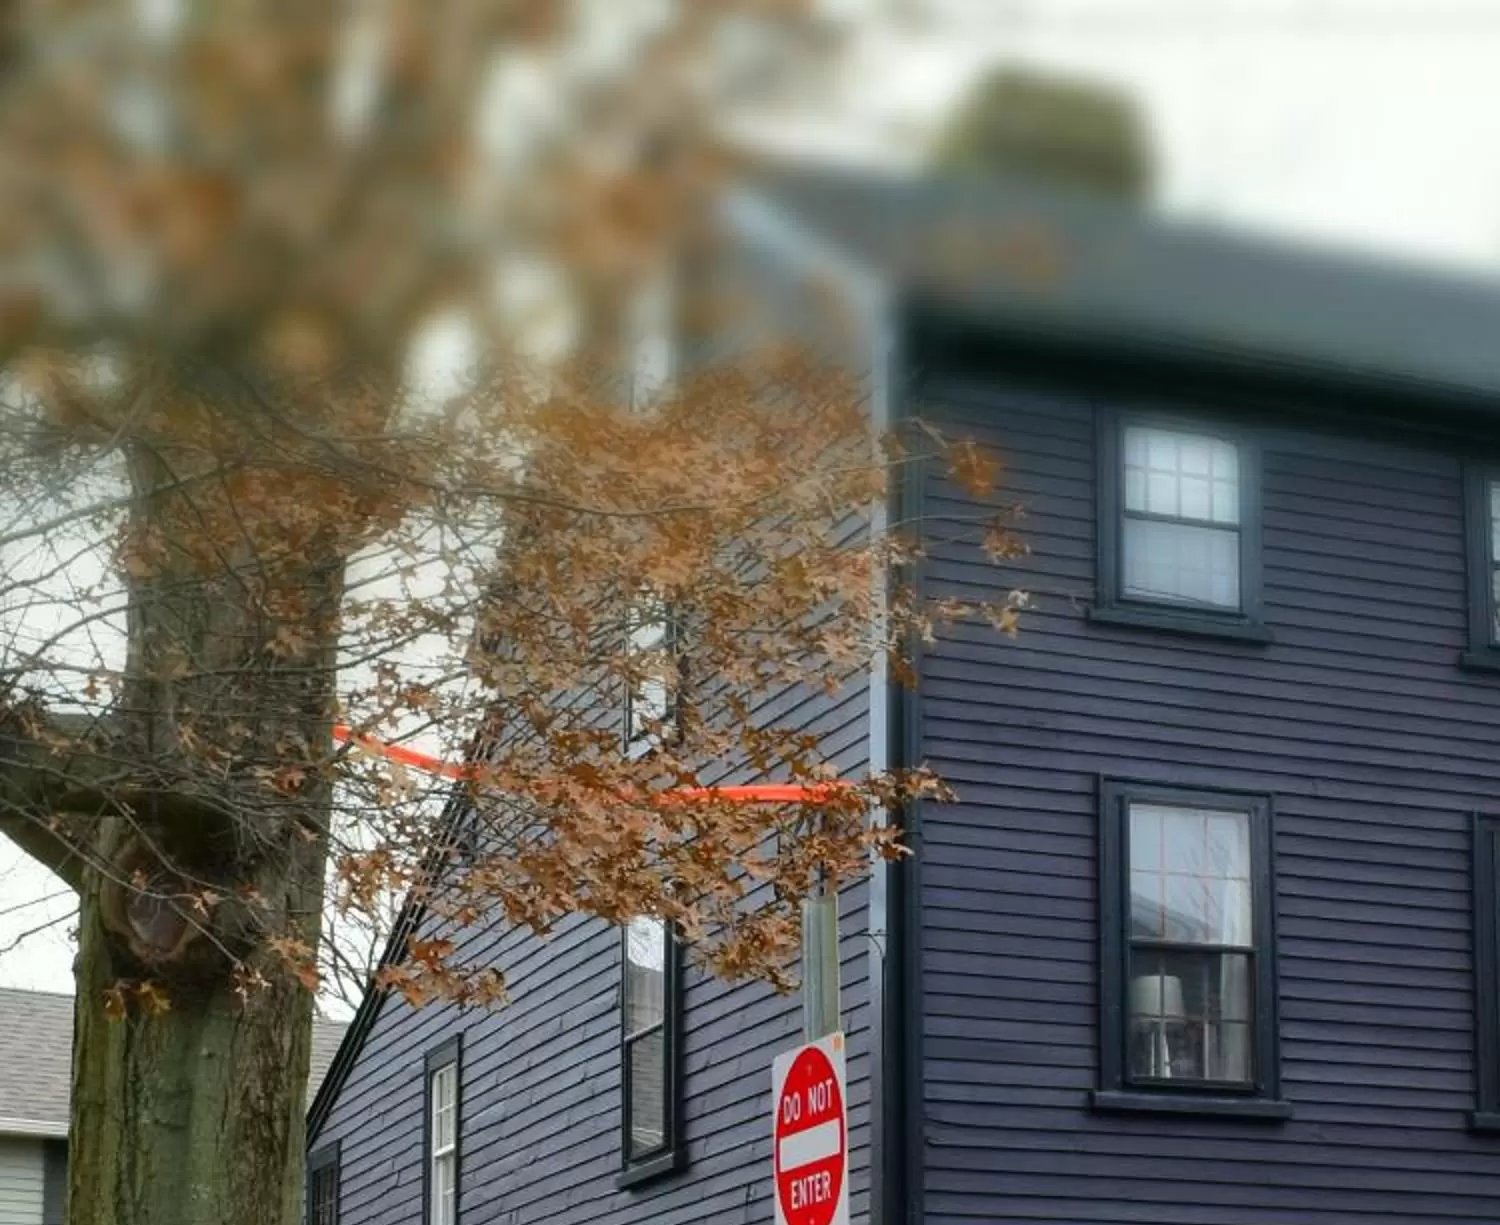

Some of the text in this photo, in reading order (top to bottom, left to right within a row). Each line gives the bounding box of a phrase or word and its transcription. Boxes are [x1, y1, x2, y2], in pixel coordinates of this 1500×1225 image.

[783, 1079, 833, 1125] DO NOT
[791, 1170, 831, 1210] ENTER
